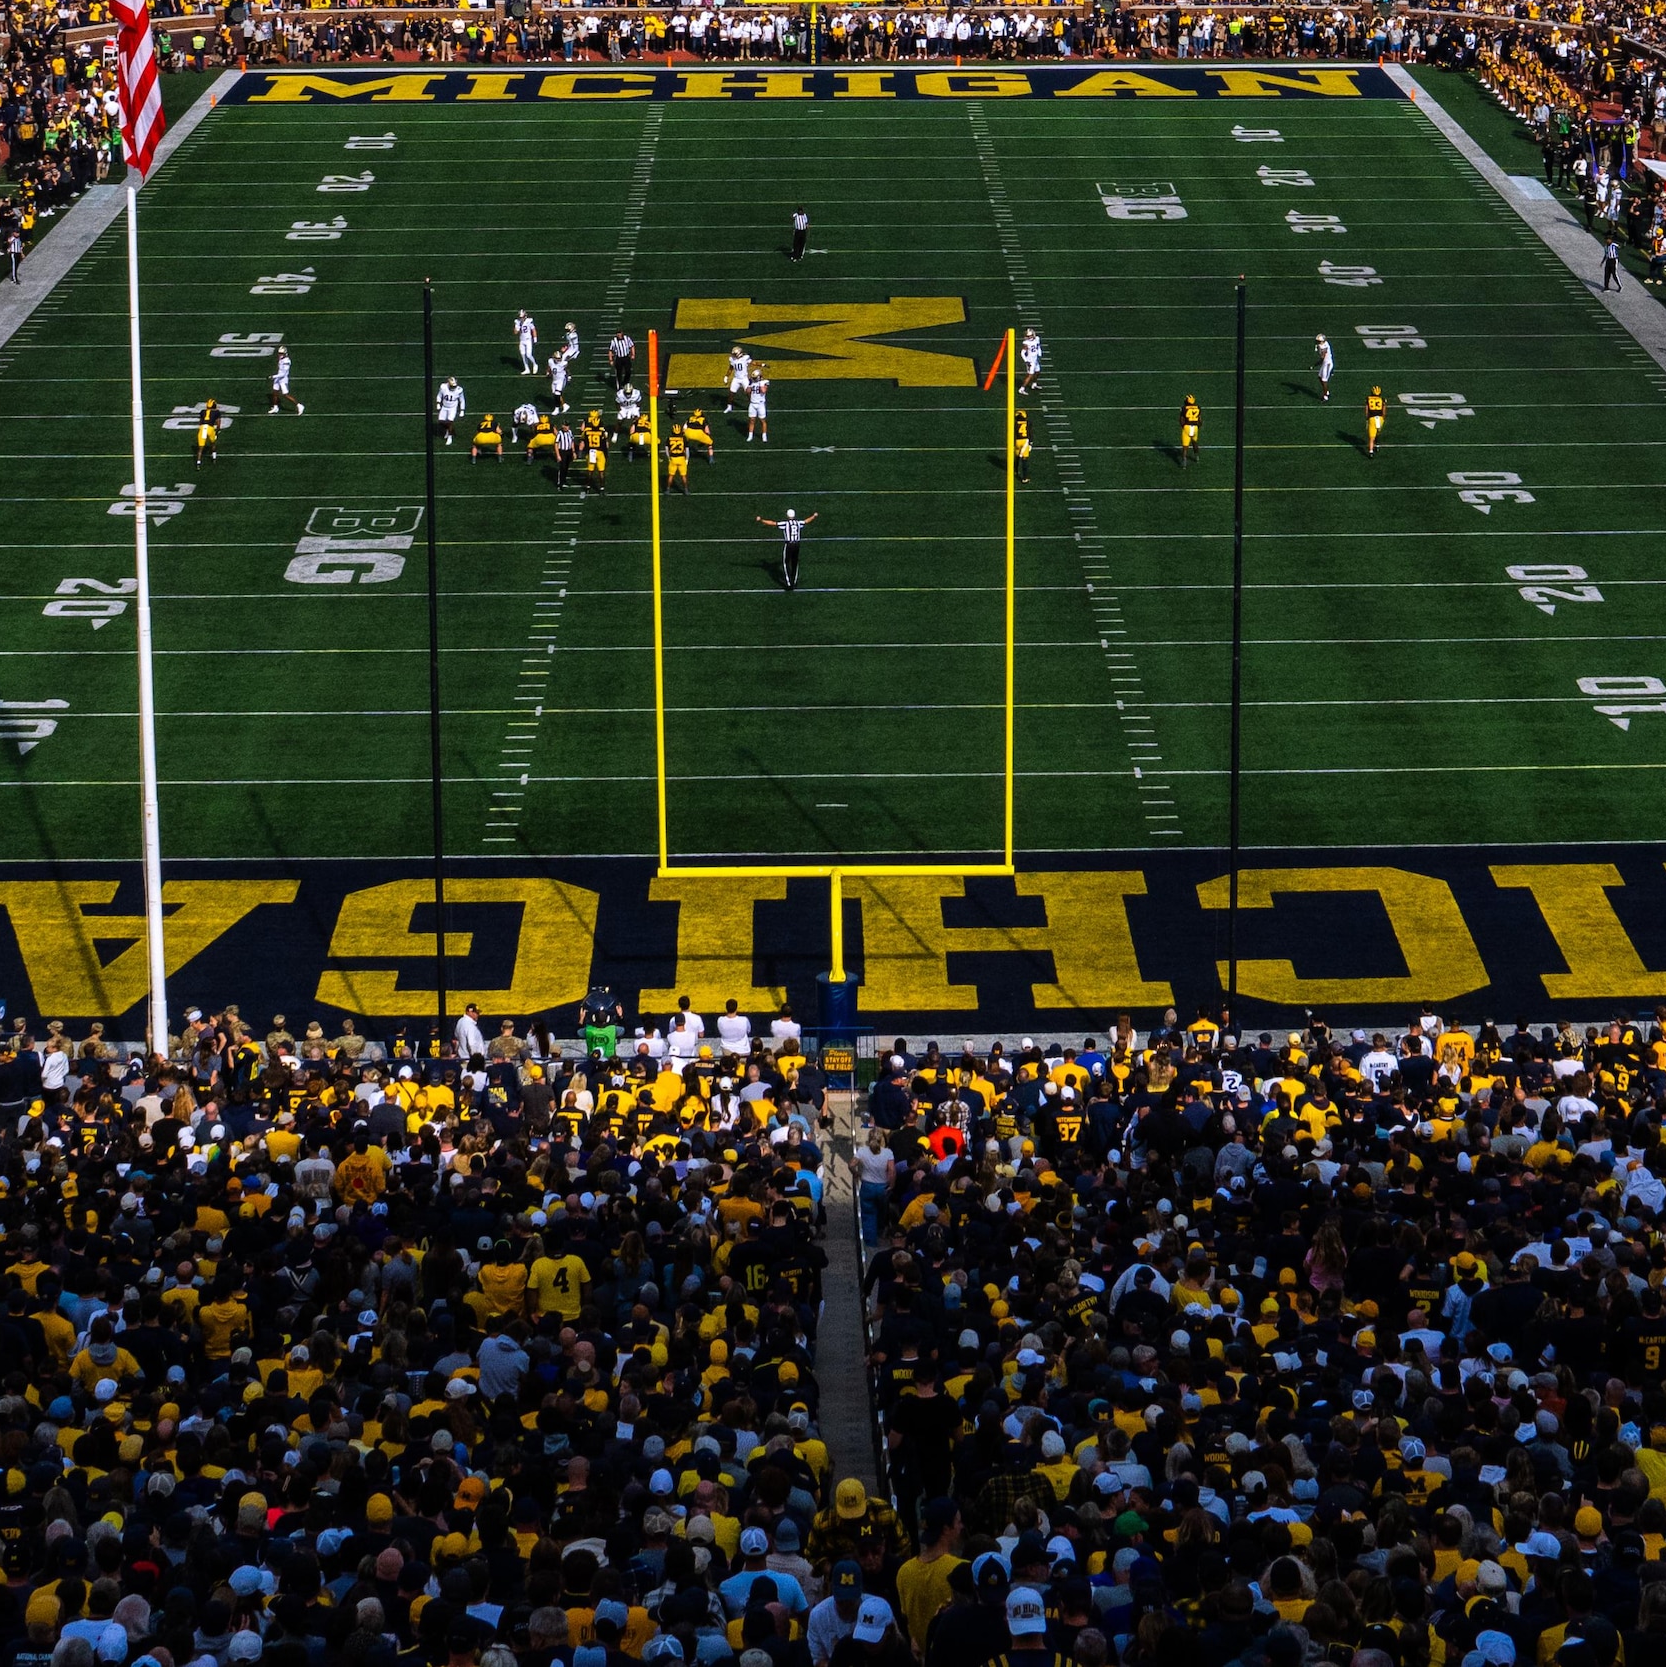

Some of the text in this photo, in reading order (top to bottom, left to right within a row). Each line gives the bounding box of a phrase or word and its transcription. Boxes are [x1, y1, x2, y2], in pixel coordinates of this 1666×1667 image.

[247, 71, 1362, 102] MICHIGAN
[316, 176, 375, 191] 20
[1256, 170, 1315, 186] 20
[285, 221, 348, 239] 30
[1285, 215, 1347, 233] 30
[249, 274, 317, 294] 40
[1317, 266, 1383, 286] 40
[210, 333, 283, 357] 50
[663, 294, 981, 391] M
[1355, 325, 1428, 348] 50
[1186, 409, 1200, 422] 42
[1397, 393, 1475, 420] 40
[588, 436, 600, 447] 19
[669, 441, 684, 453] 23
[1446, 471, 1536, 504] 30
[1505, 564, 1605, 603] 20
[42, 577, 138, 618] 20
[825, 1056, 852, 1064] STAY OFF
[1225, 1078, 1238, 1093] 2
[1058, 1124, 1081, 1142] 97
[553, 1268, 568, 1293] 4
[744, 1263, 765, 1292] 16
[1409, 1289, 1439, 1300] WOODSON
[1645, 1346, 1660, 1370] 9
[1098, 1411, 1109, 1421] M
[861, 1524, 872, 1536] M
[840, 1572, 854, 1586] M
[863, 1614, 874, 1624] M
